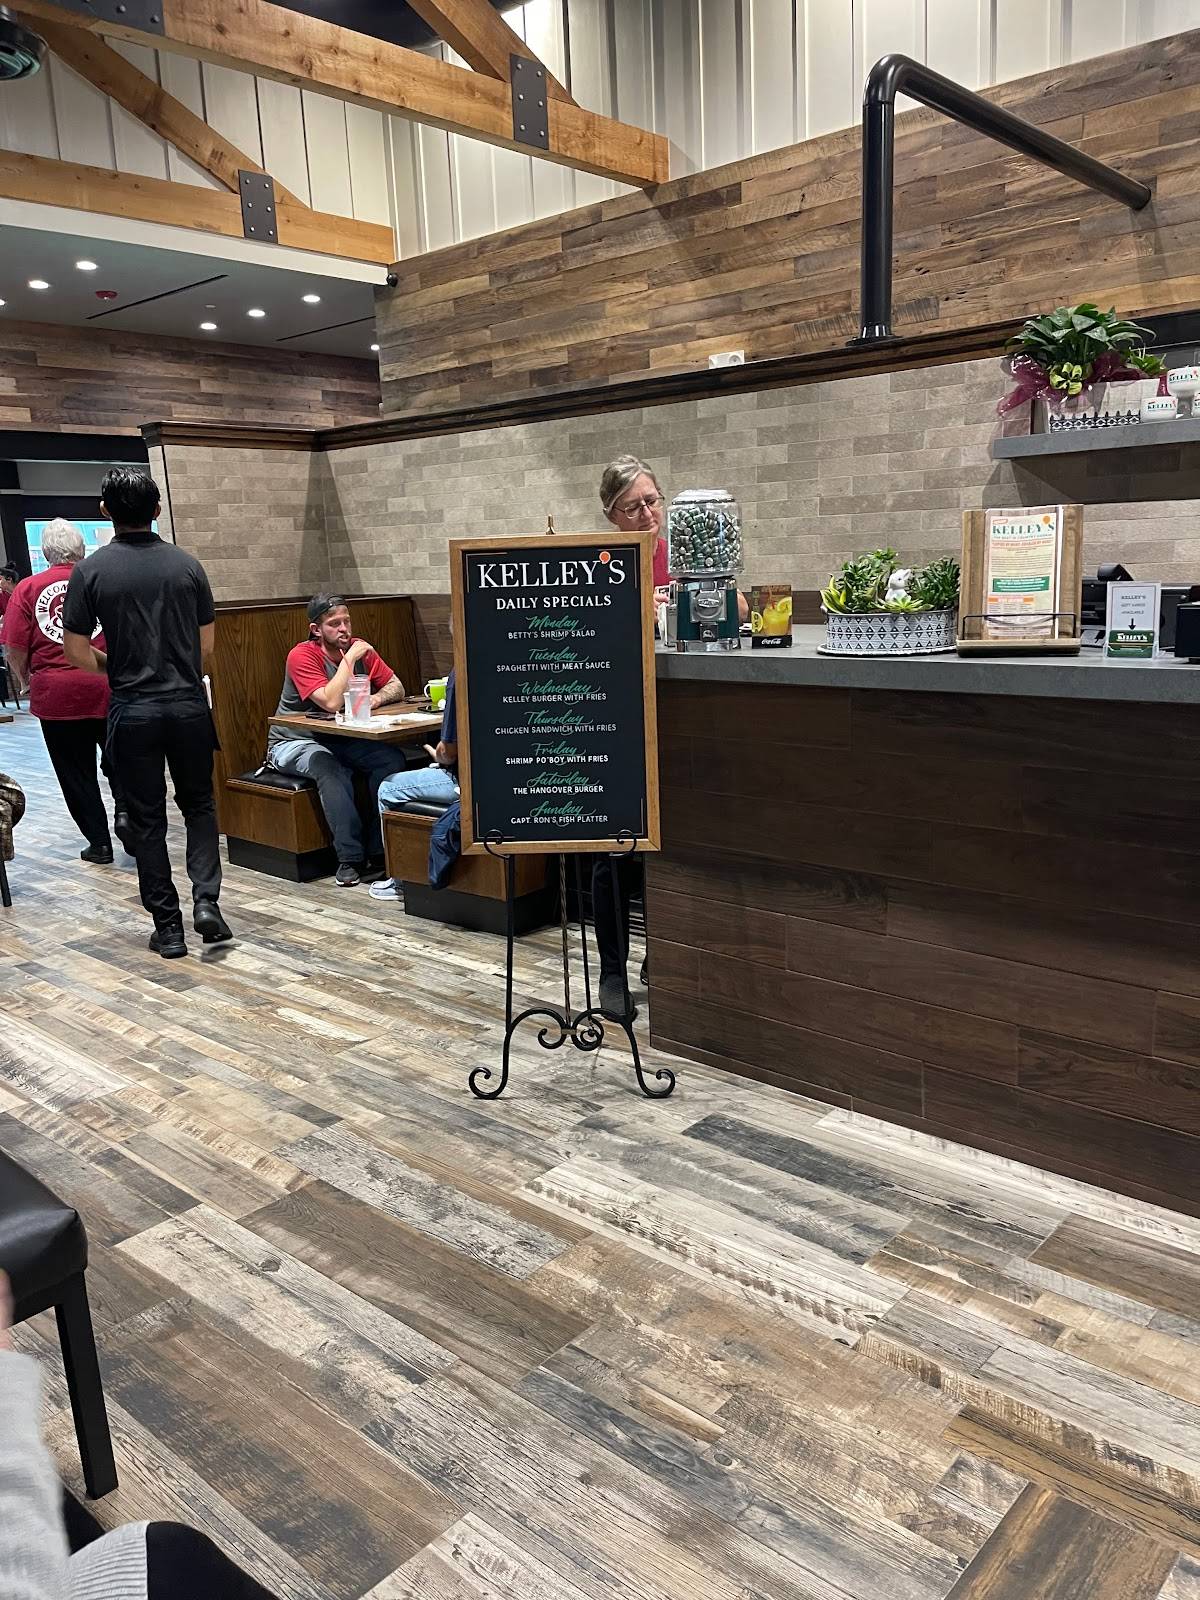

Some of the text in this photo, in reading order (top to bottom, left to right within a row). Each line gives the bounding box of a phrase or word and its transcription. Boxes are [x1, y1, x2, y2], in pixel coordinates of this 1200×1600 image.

[992, 515, 1055, 534] KELLEY'S
[477, 551, 626, 589] KELLEY'S
[496, 595, 612, 610] DAILY SPECIALS
[525, 615, 586, 634] Monday
[508, 629, 596, 639] BETTY'S SHRIMP SALAD
[528, 646, 589, 662] Tuesday
[496, 661, 611, 672] SPAGHETTI WITH MEAT SAUCE
[517, 679, 601, 694] Wednesday
[502, 696, 530, 704] KELLEY
[564, 693, 584, 701] WITH
[586, 693, 607, 701] FRIES
[524, 709, 593, 726] Thursday
[495, 723, 617, 735] CHICKEN SANDWICH WITH FRIES
[531, 740, 587, 757] Friday
[505, 757, 533, 765] SHRIMP
[566, 755, 586, 763] WITH
[587, 754, 609, 762] FRIES
[526, 771, 599, 788] Saturday
[513, 785, 604, 795] THE HANGOVER BURGER
[529, 800, 596, 817] Sunday
[510, 815, 608, 824] CAPT. RON'S FISH PLATTER
